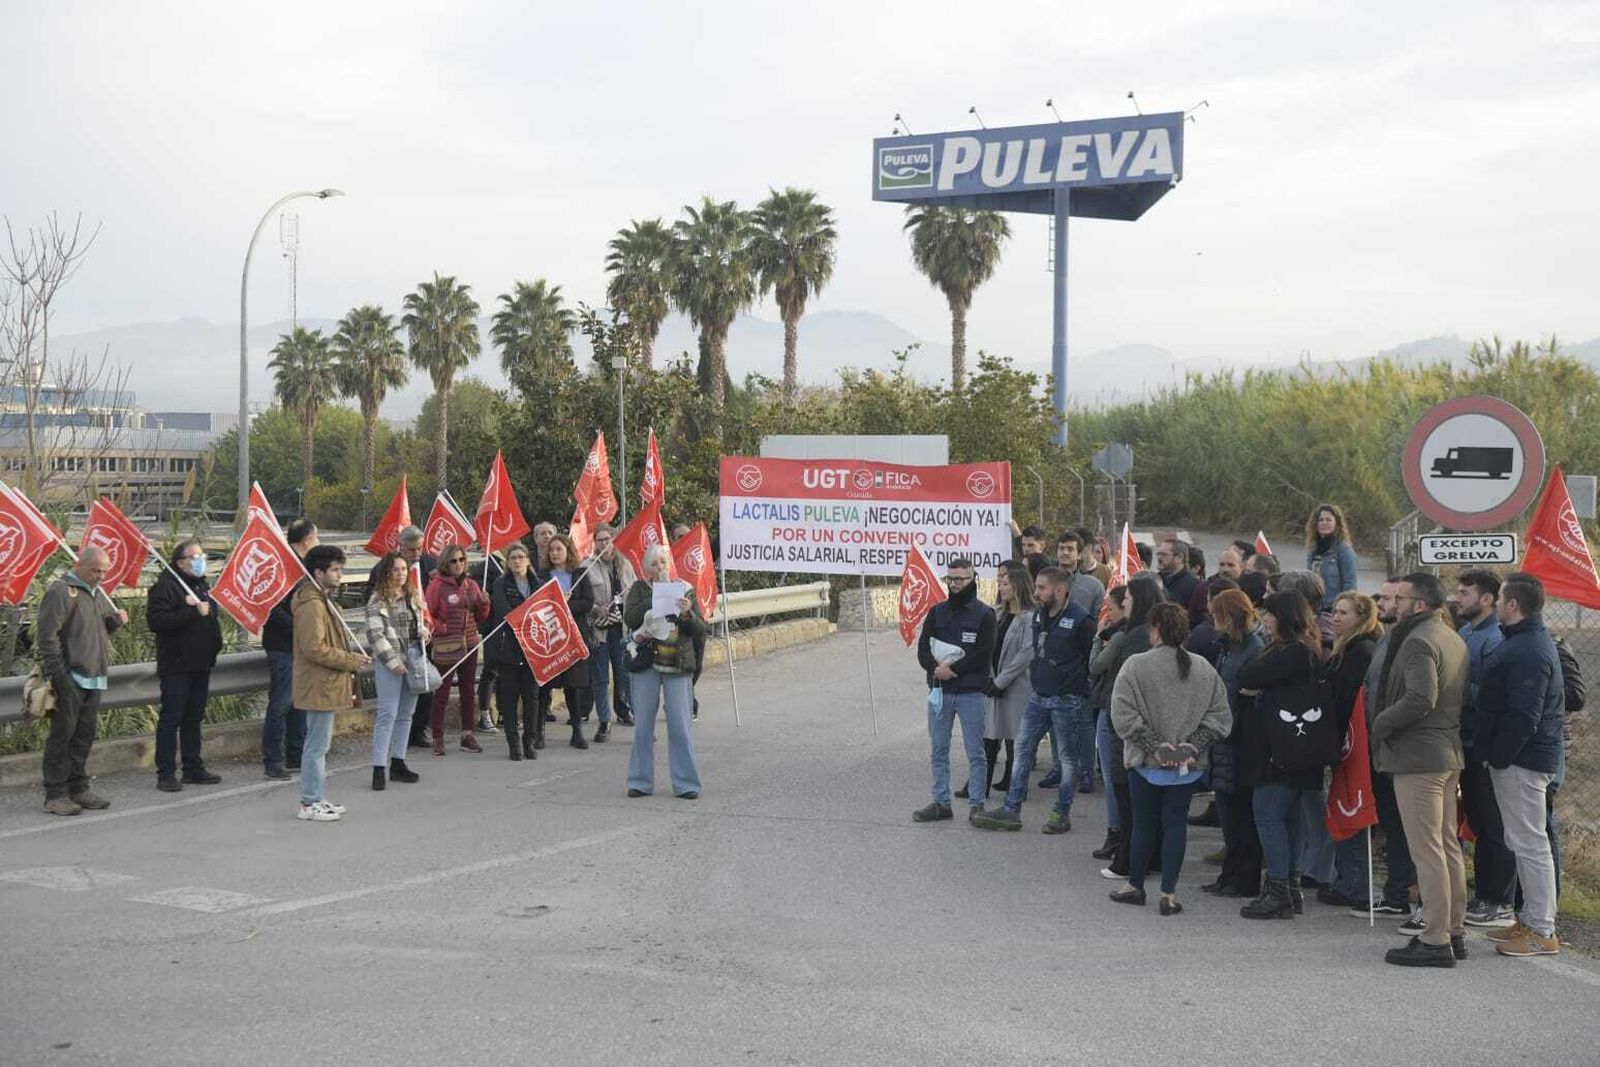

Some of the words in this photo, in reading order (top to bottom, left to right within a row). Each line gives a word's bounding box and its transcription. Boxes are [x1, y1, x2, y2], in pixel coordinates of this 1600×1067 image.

[884, 154, 929, 166] PULEVA
[937, 128, 1174, 190] PULEVA
[803, 468, 850, 489] UGT
[885, 471, 922, 487] FICA
[733, 502, 800, 521] LACTALIS
[804, 505, 860, 522] PULEVA
[864, 504, 972, 528] ¡NEGOCIACIÓN
[976, 509, 1000, 527] YA!
[772, 527, 806, 542] POR
[812, 529, 834, 543] UN
[839, 530, 927, 546] CONVENIO
[932, 532, 970, 547] CON
[1430, 539, 1503, 549] EXCEPTO
[727, 543, 785, 561] JUSTICIA
[788, 545, 856, 565] SALARIAL,
[1434, 551, 1499, 561] GRELVA
